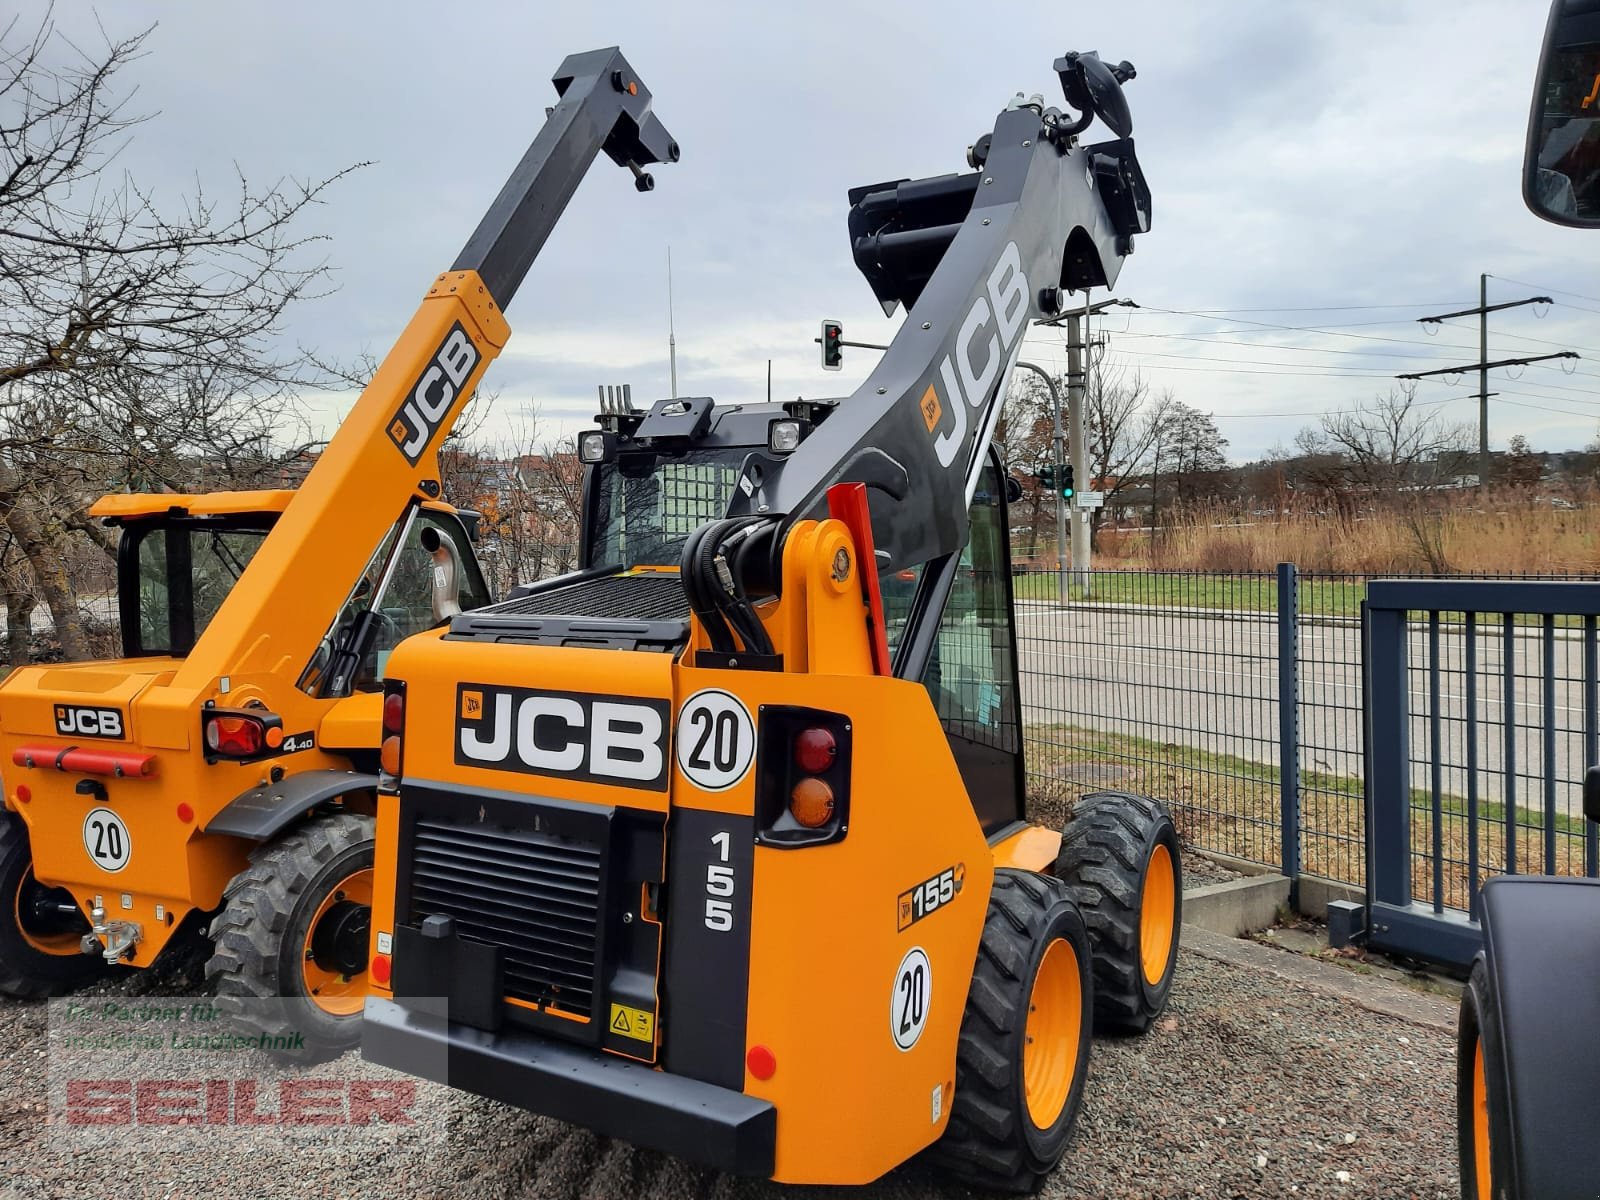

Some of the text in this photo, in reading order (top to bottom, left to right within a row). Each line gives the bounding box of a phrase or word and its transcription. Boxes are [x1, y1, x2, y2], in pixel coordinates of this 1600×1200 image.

[934, 241, 1030, 468] JCB
[401, 329, 476, 459] JCB
[58, 708, 122, 735] JCB
[459, 693, 665, 782] JCB
[688, 706, 739, 773] 20
[92, 820, 123, 861] 20
[704, 831, 734, 932] 155
[913, 869, 954, 917] 155
[900, 963, 925, 1037] 20
